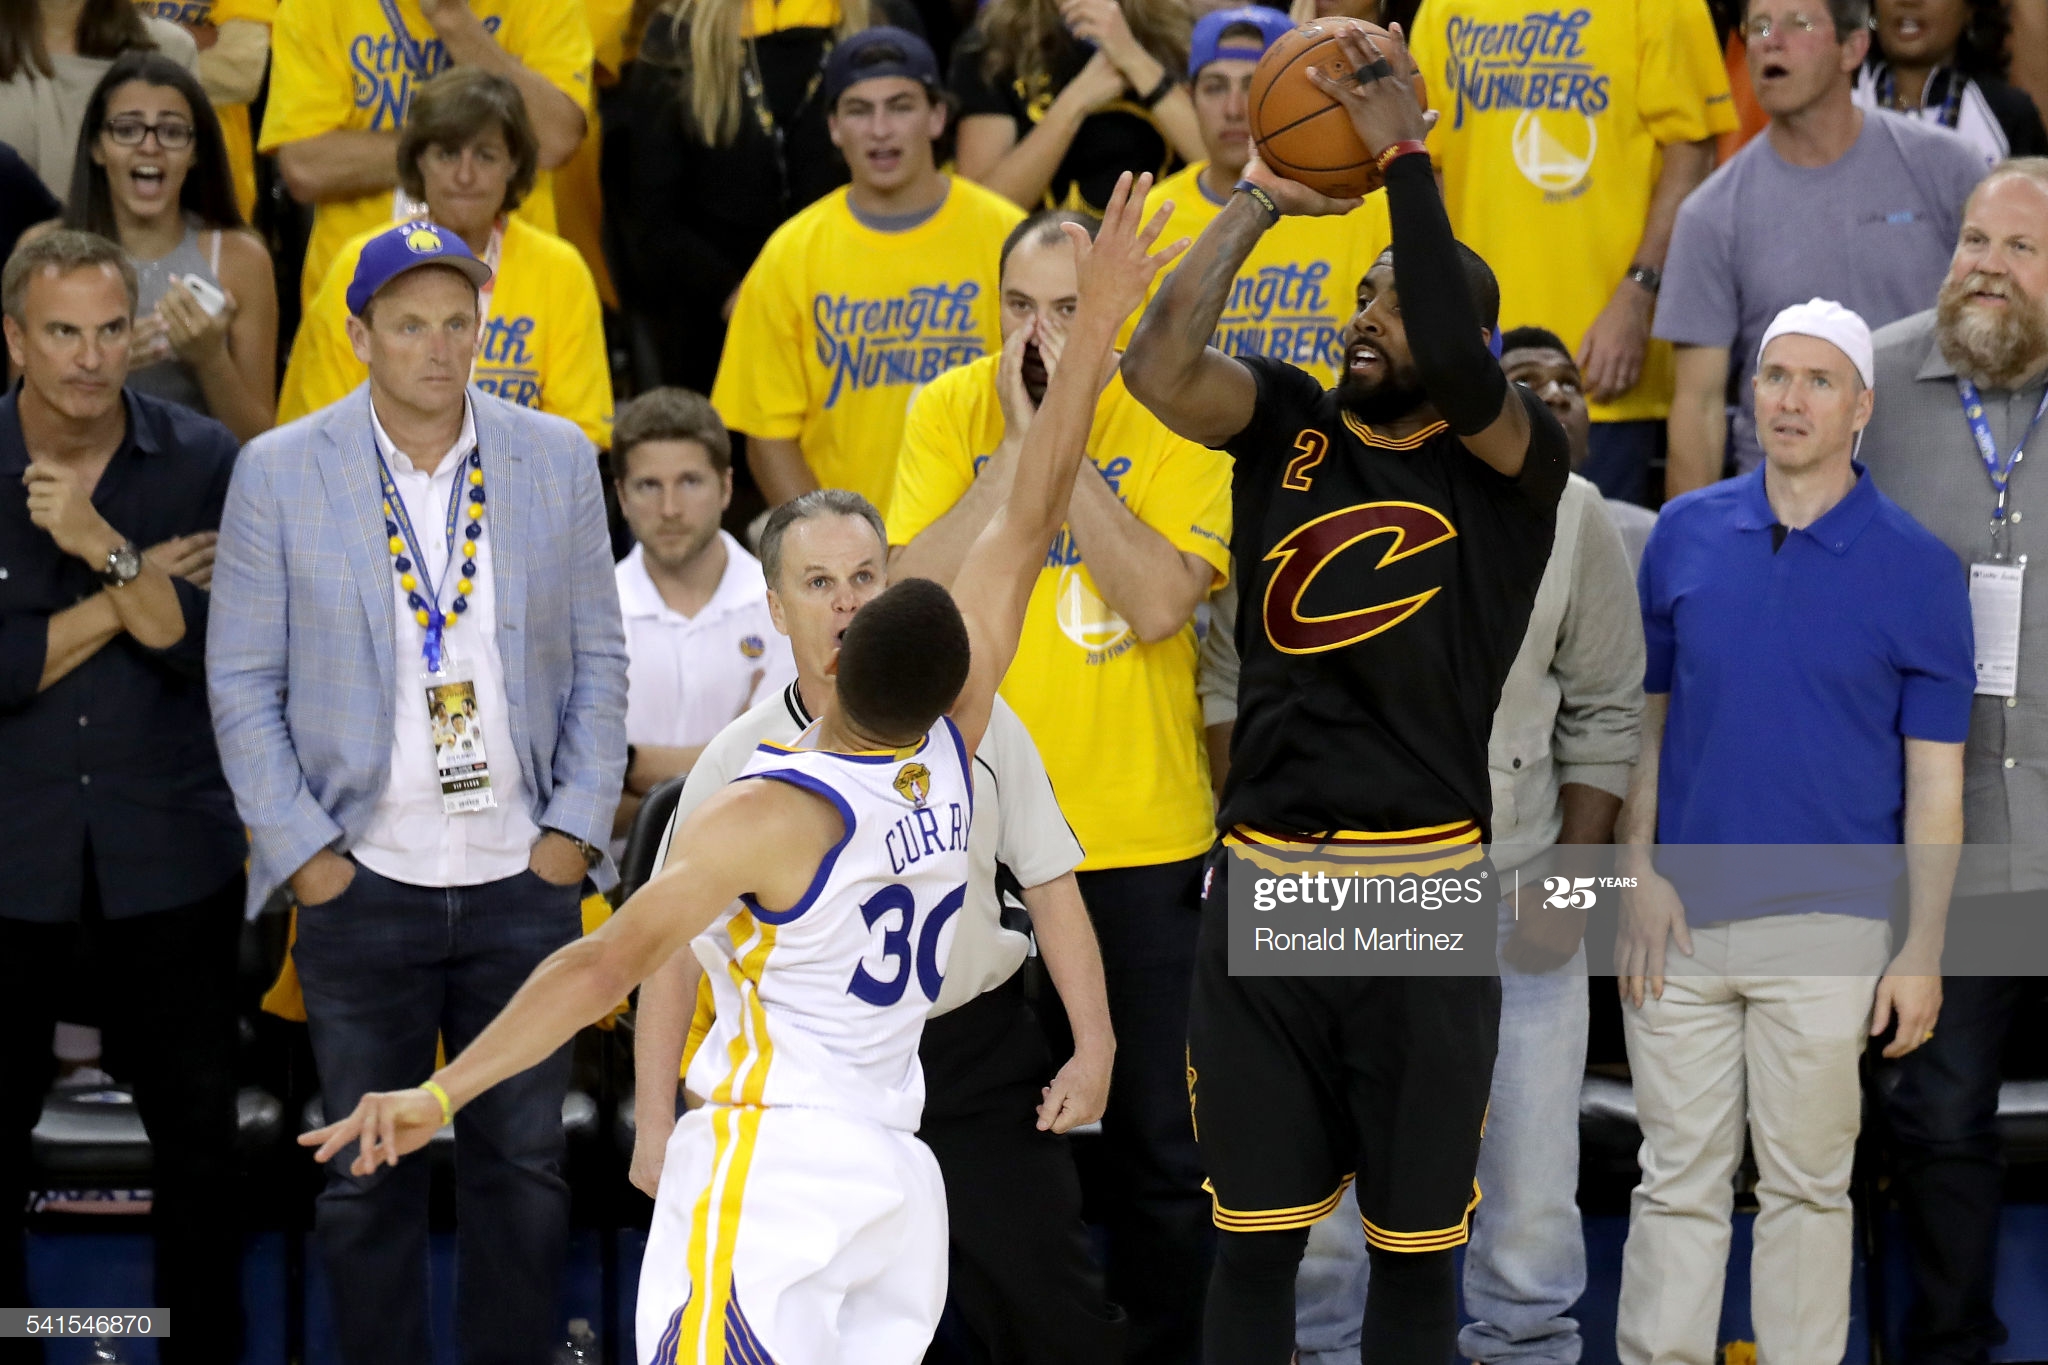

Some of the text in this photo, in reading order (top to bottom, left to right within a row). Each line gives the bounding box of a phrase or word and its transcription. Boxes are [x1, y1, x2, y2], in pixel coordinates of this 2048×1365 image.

[1446, 9, 1592, 90] Strength
[814, 281, 980, 368] Strength
[1282, 429, 1329, 492] 2
[1262, 501, 1458, 655] C
